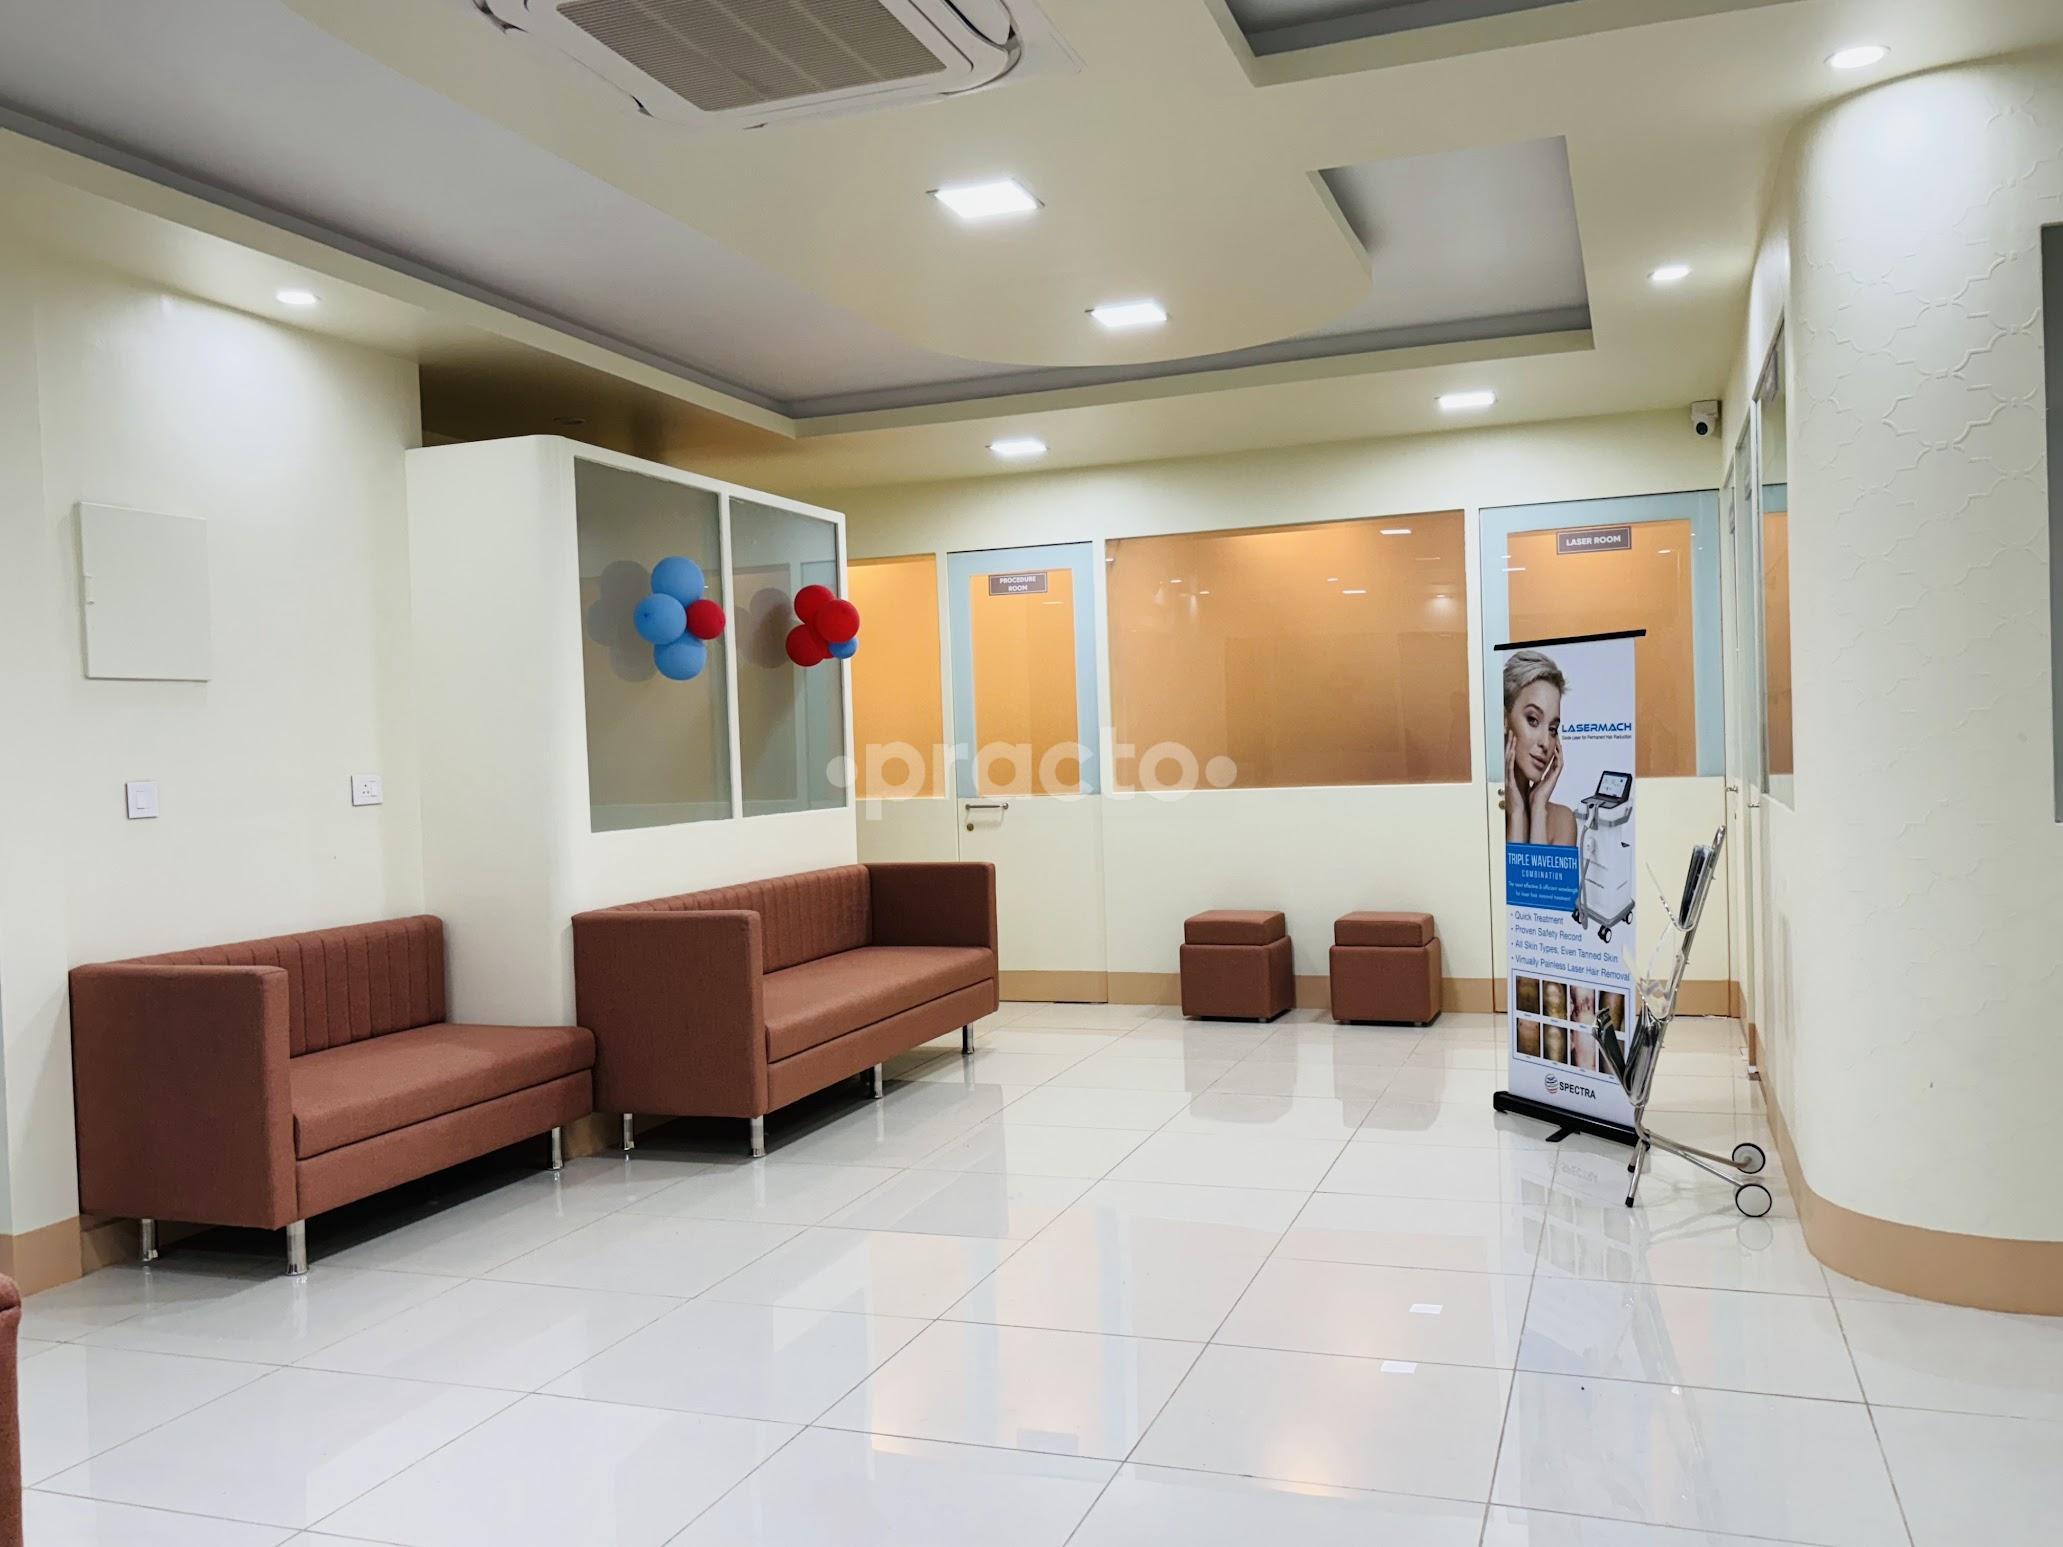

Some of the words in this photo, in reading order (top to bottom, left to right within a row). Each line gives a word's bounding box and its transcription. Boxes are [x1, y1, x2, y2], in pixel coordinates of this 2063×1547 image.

[1566, 537, 1592, 546] LASER
[1594, 535, 1621, 544] ROOM
[1000, 576, 1036, 584] PROCEDURE
[1562, 722, 1632, 732] LASERMACH
[1508, 852, 1530, 866] TRIPLE
[1530, 854, 1578, 870] WAVELENGTH
[1522, 869, 1563, 880] COMBINATION
[1514, 910, 1532, 921] Quick
[1534, 912, 1564, 925] Treatment
[1516, 924, 1536, 936] Proven
[1538, 928, 1558, 940] Safety
[1560, 930, 1582, 942] Record
[1524, 940, 1538, 950] Skin
[1560, 946, 1576, 956] Even
[1578, 948, 1602, 960] Tanned
[1604, 952, 1618, 962] Skin
[1516, 955, 1538, 968] Virtually
[1540, 958, 1566, 971] Painless
[1568, 963, 1584, 974] Laser
[1586, 965, 1599, 976] Hair
[1601, 968, 1630, 982] Removal
[1560, 1082, 1596, 1100] SPECTRA
